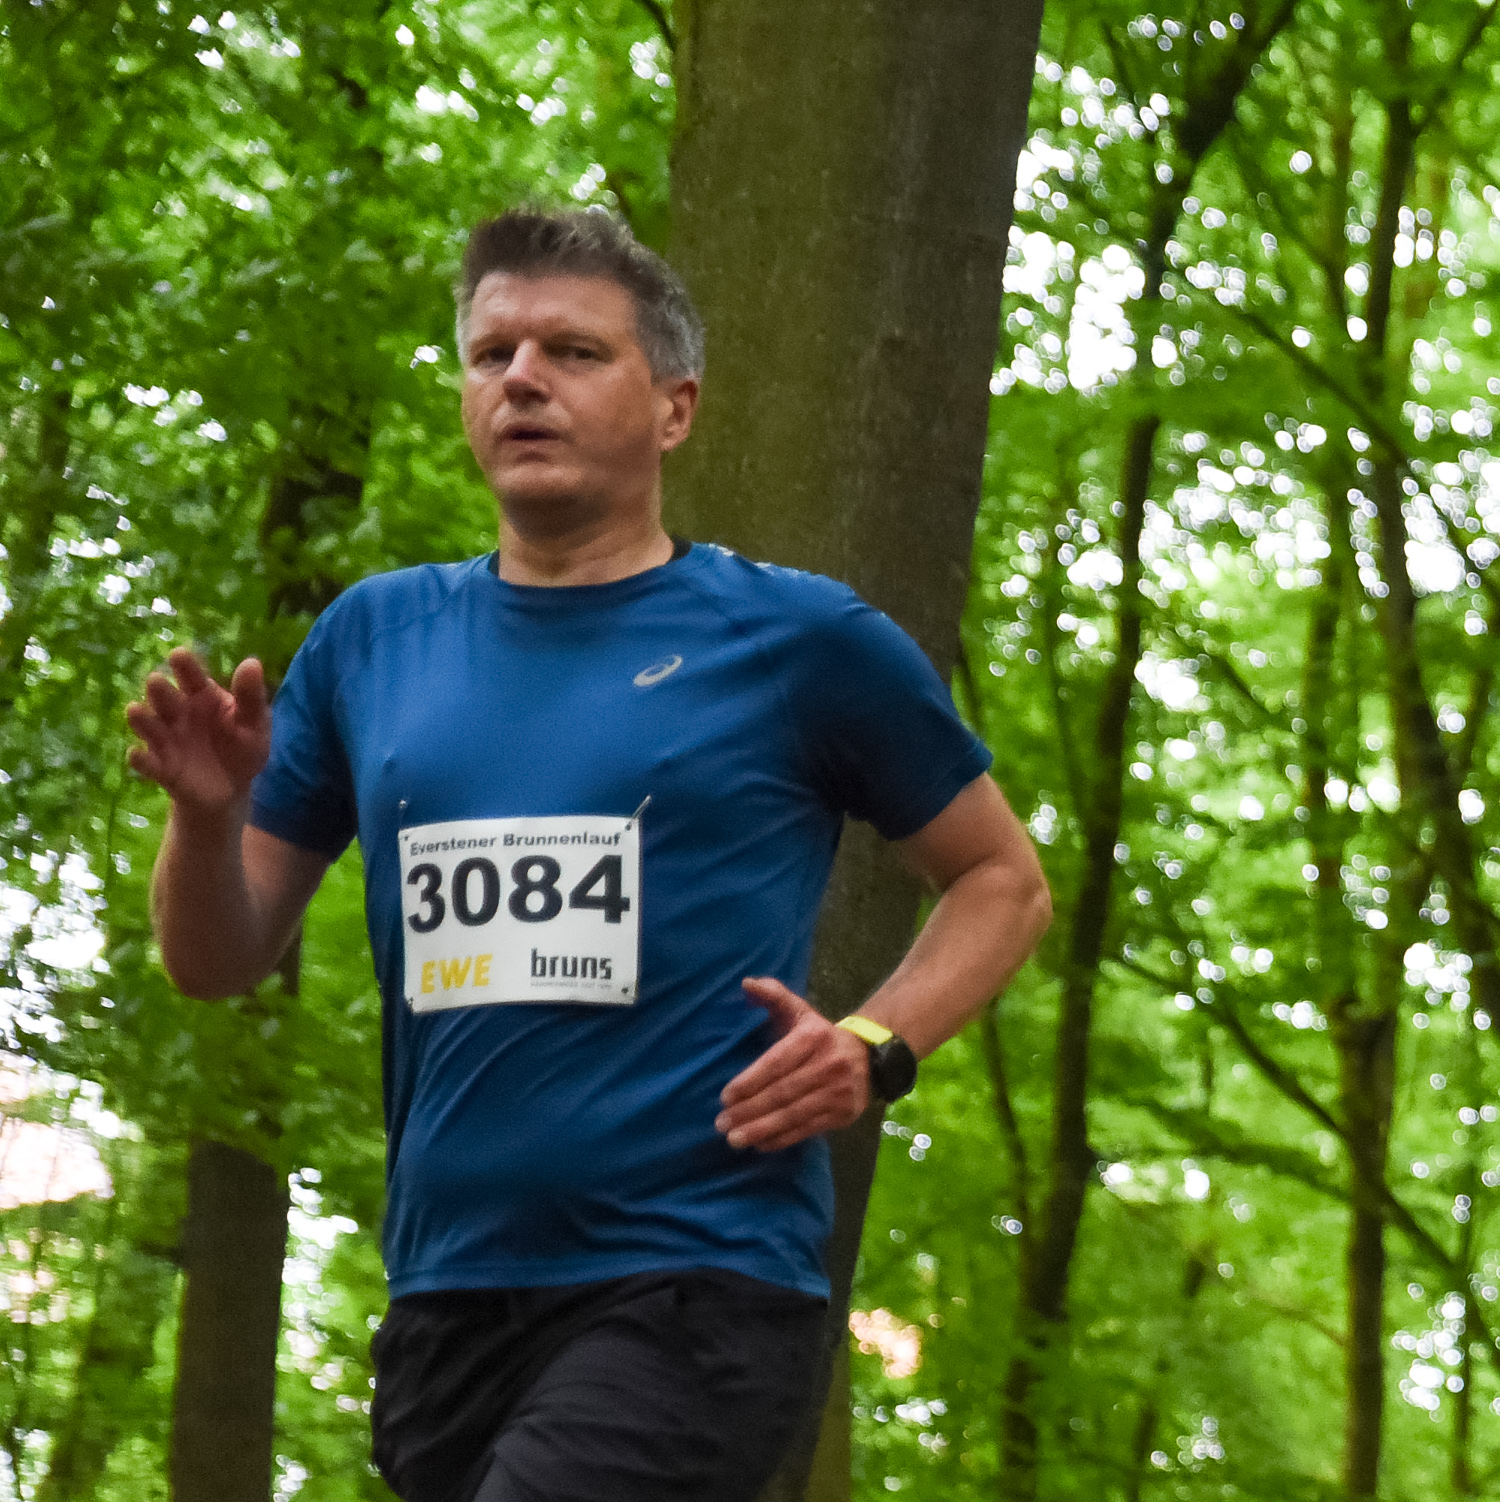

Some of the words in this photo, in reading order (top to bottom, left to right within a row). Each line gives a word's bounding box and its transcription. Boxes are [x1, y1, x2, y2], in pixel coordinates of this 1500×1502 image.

[409, 835, 497, 857] Everstener
[502, 831, 622, 848] Brunnenlauf
[406, 854, 631, 934] 3084
[420, 952, 494, 995] EWE
[530, 947, 613, 981] bruns
